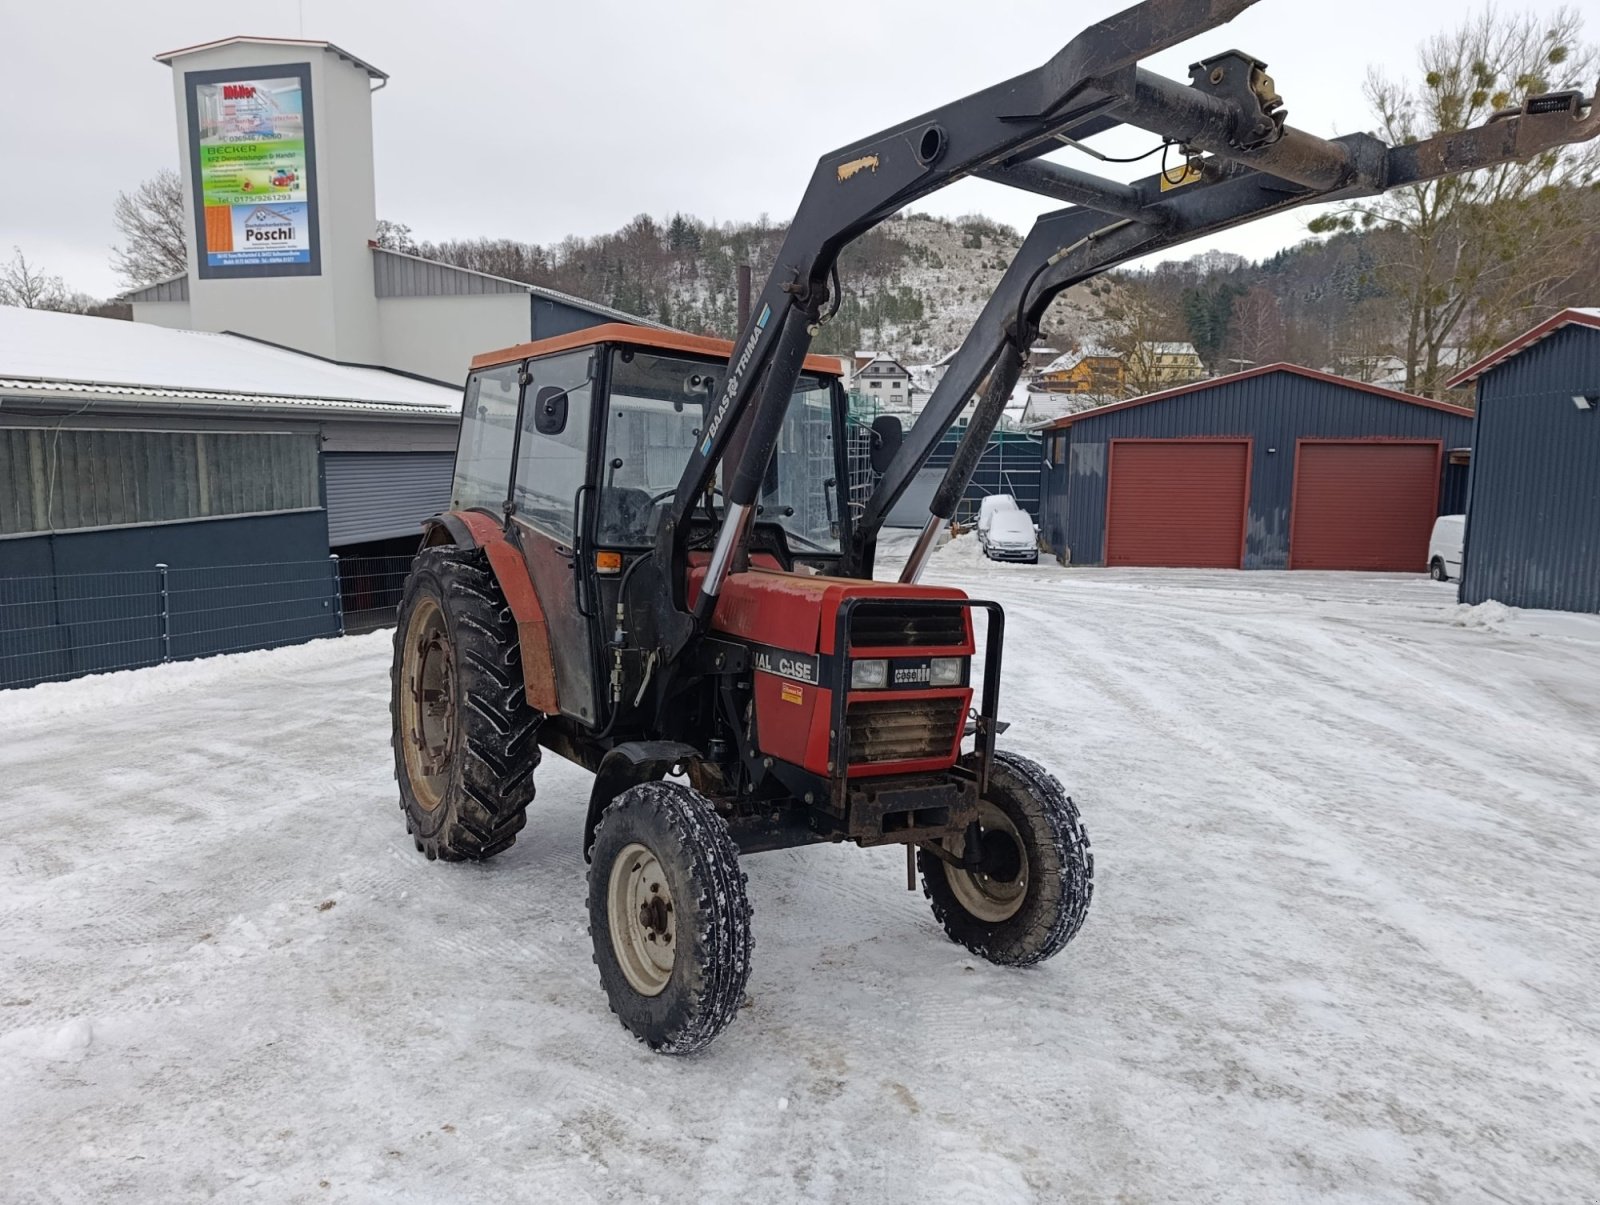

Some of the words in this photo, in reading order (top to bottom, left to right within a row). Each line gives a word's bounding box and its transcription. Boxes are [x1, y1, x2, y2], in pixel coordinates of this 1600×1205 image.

[207, 144, 257, 155] BECKER
[246, 227, 292, 241] Pöschl
[708, 394, 730, 439] BAAS
[734, 326, 762, 378] TRIMA
[779, 658, 811, 680] CASE
